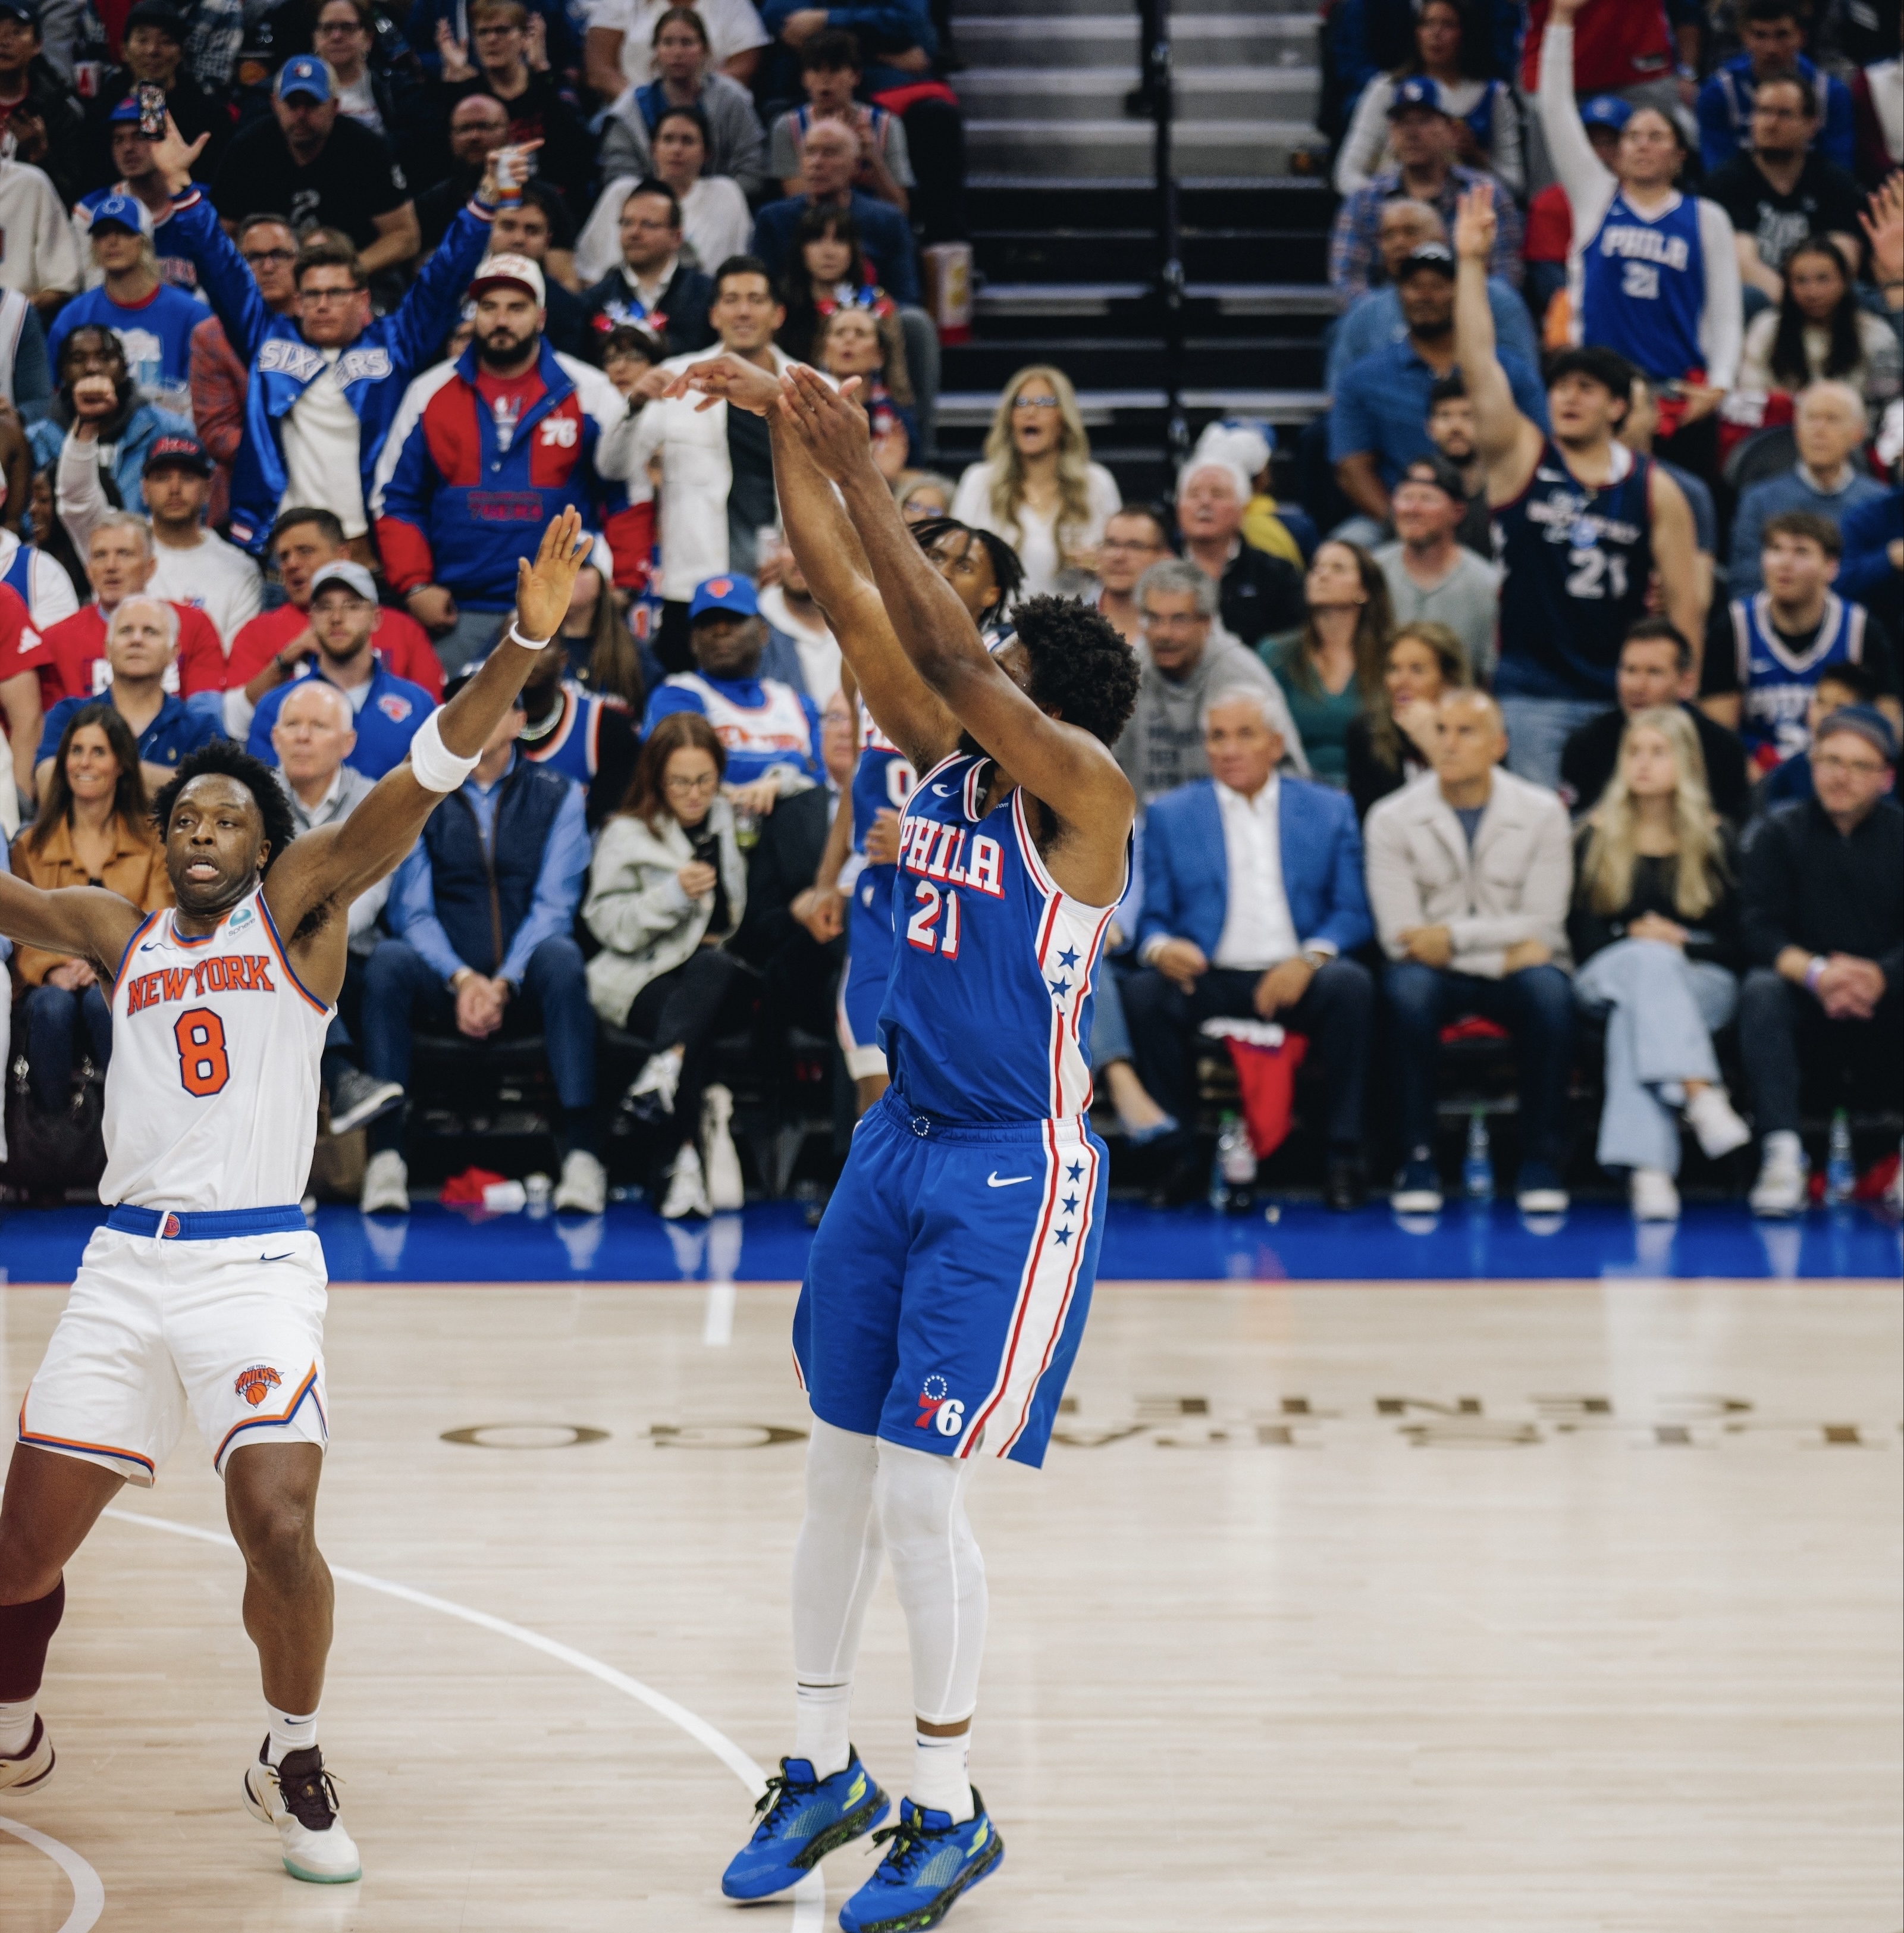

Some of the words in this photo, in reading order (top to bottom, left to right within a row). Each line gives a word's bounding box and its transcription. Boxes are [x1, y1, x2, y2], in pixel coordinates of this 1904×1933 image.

[1600, 225, 1689, 272] PHILA
[540, 418, 578, 448] 76
[1566, 547, 1629, 600] 21
[897, 816, 1005, 900] PHILA
[228, 918, 256, 936] sphere
[907, 880, 961, 960] 21
[127, 967, 193, 1018] NEW
[193, 954, 277, 998] YORK
[174, 1007, 231, 1098] 8
[235, 1367, 283, 1396] KNICKS
[914, 1392, 965, 1437] 76
